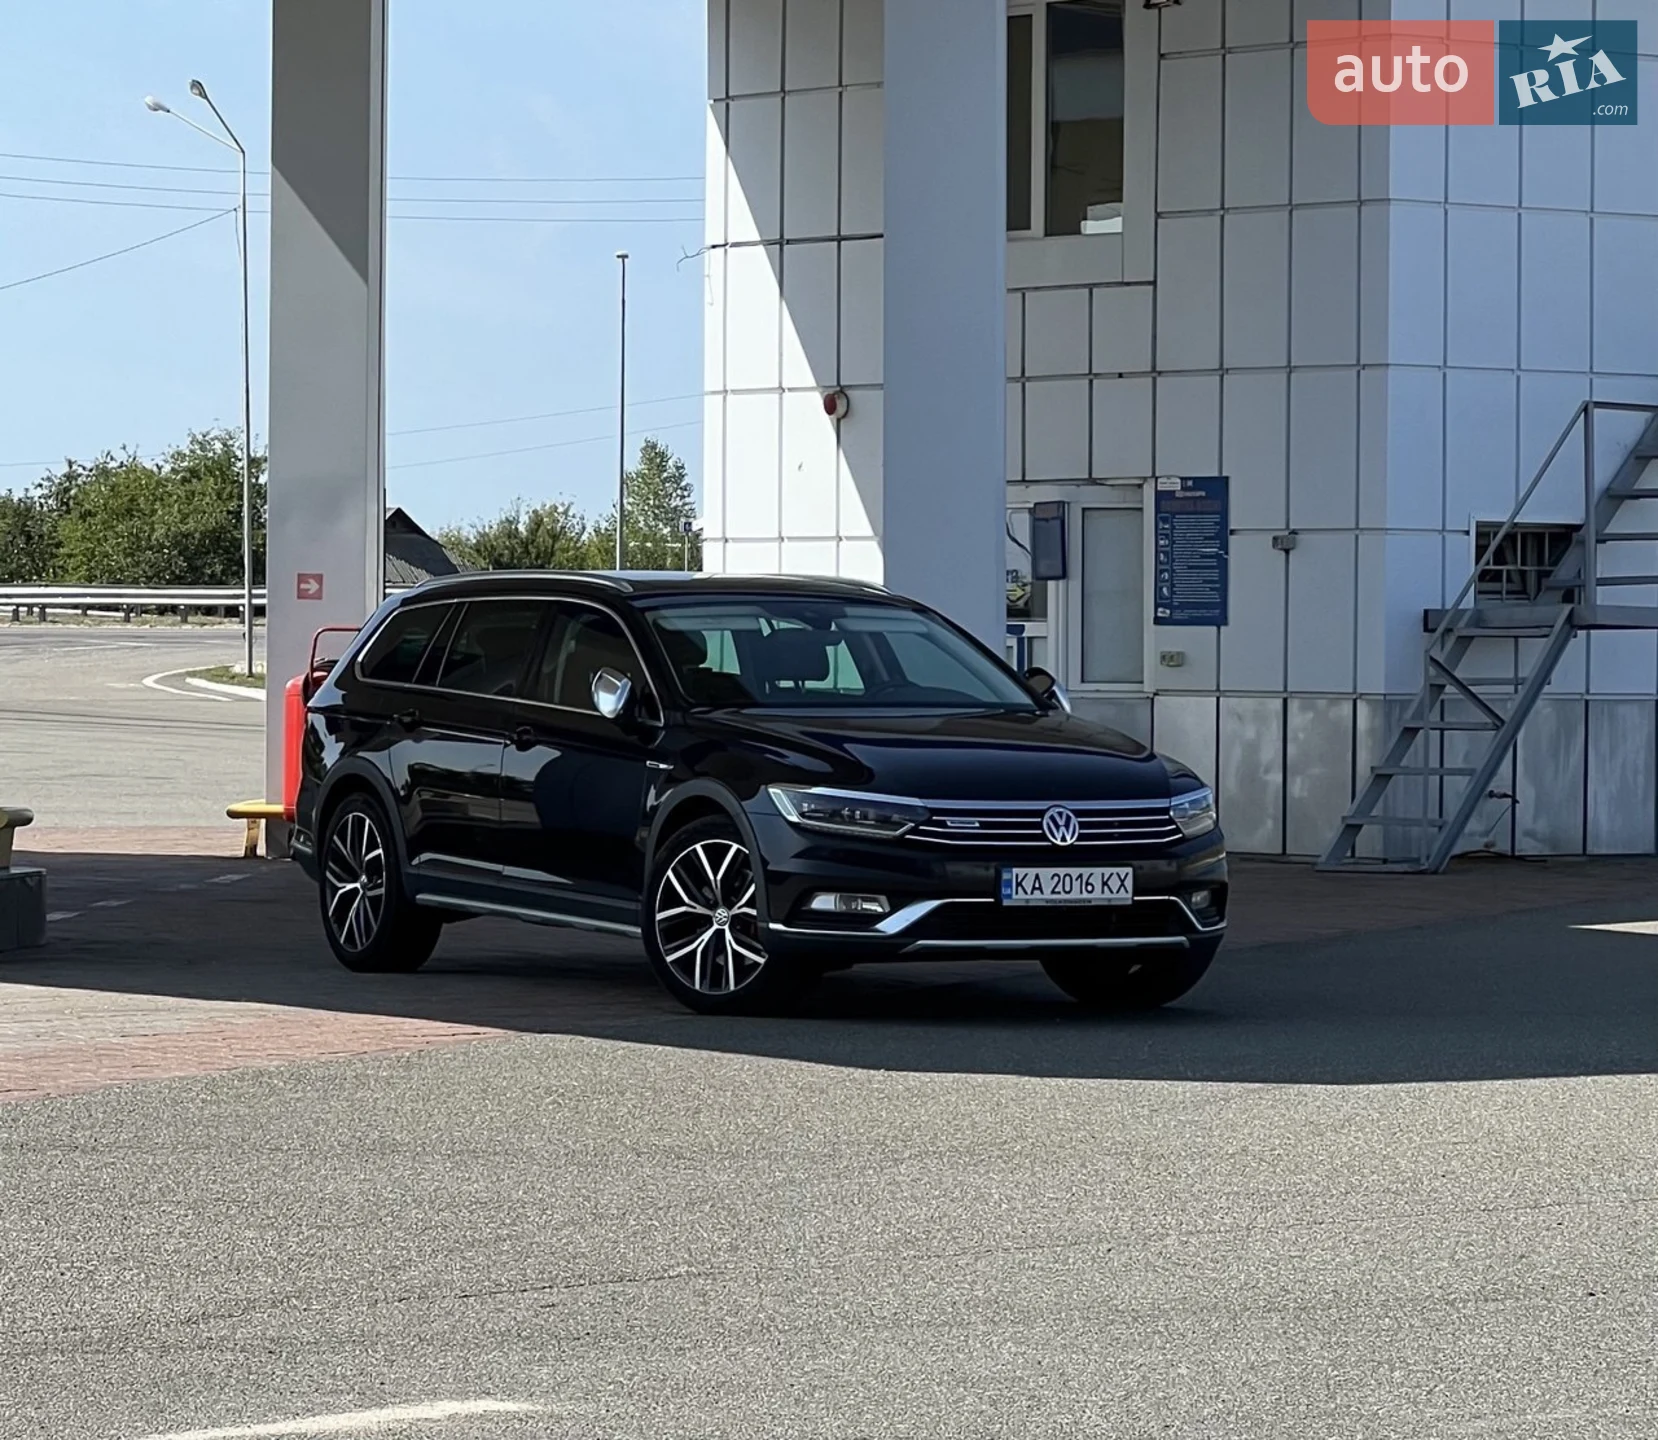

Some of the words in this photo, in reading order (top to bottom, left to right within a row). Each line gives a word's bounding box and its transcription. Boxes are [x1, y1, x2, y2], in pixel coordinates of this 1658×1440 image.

[1015, 873, 1044, 895] KA
[1050, 872, 1095, 895] 2016
[1101, 872, 1130, 894] KX
